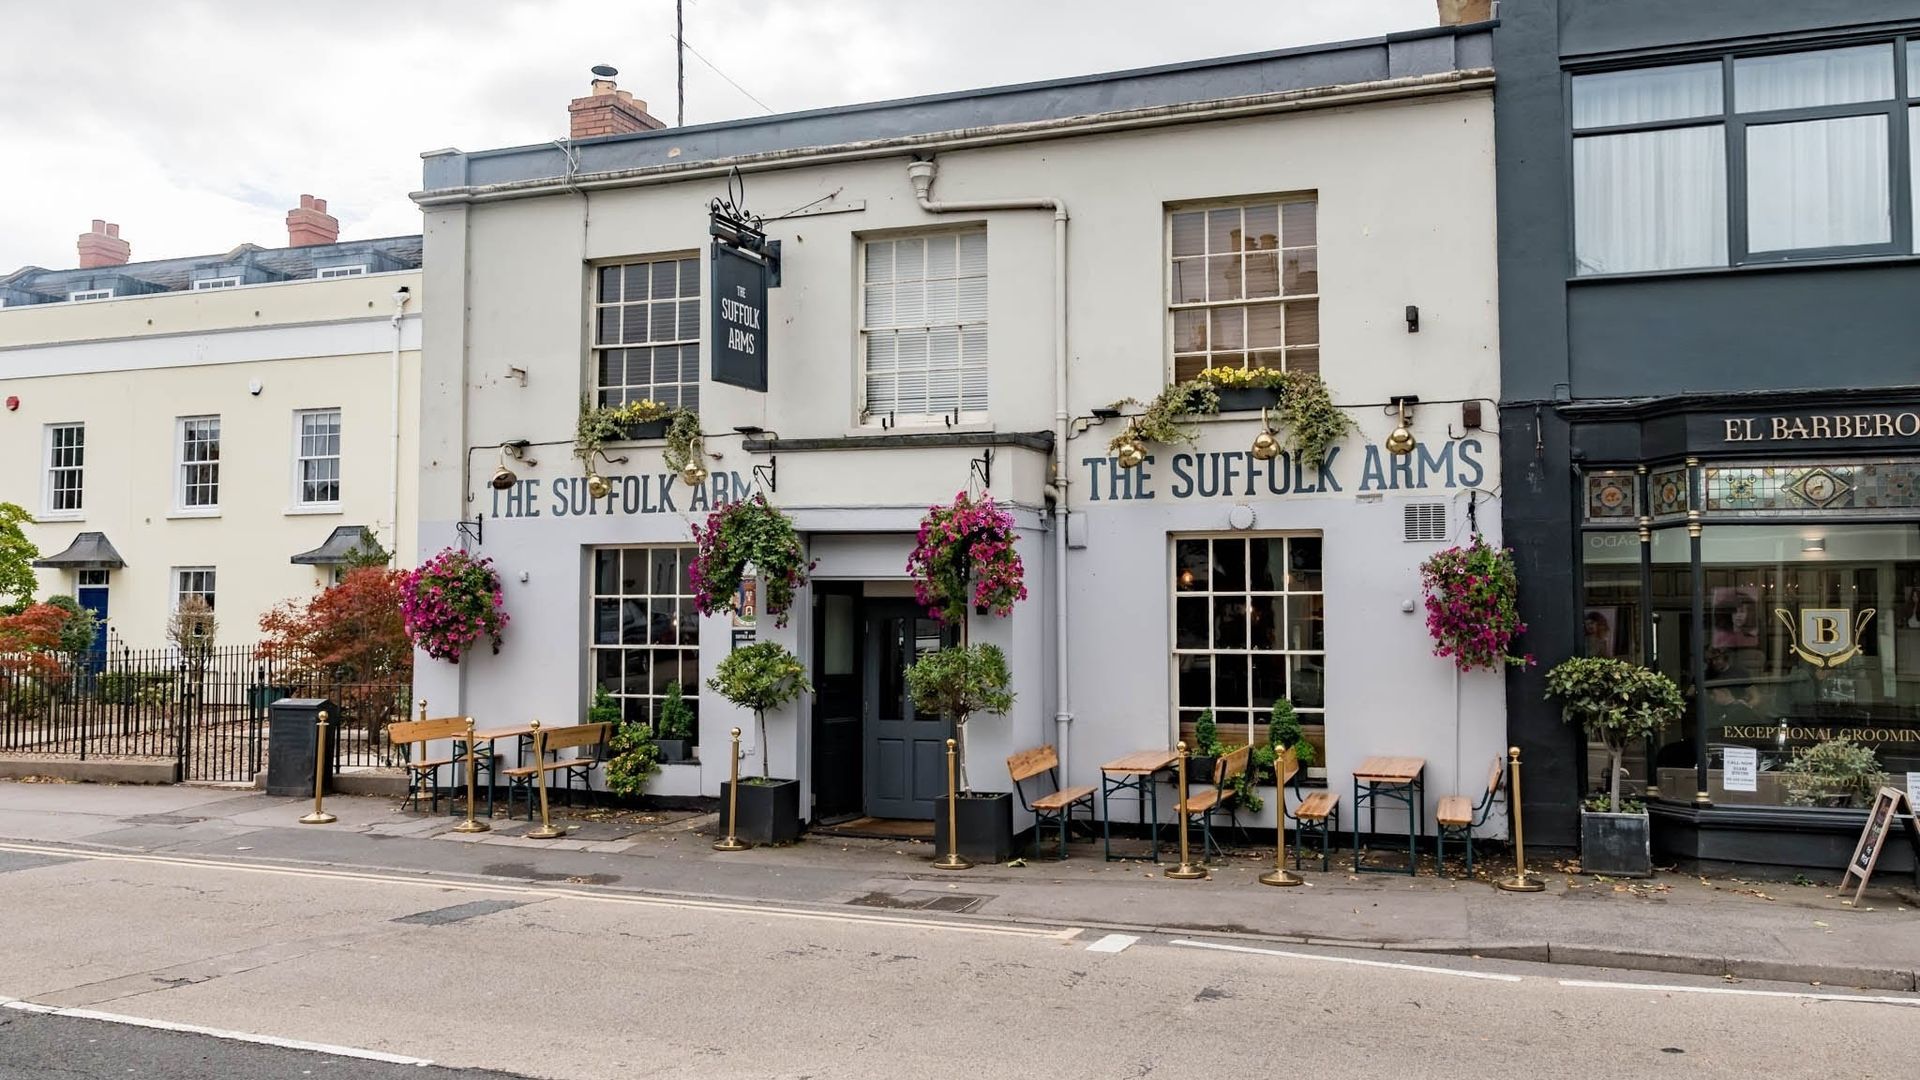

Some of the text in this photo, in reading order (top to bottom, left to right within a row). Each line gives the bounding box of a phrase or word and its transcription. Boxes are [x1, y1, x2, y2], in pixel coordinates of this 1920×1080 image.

[736, 285, 747, 299] THE
[721, 297, 760, 330] SUFFOLK
[728, 327, 755, 355] ARMS
[1724, 412, 1920, 442] EL BARBERO
[1082, 438, 1484, 501] THE SUFFOLK ARMS
[487, 479, 541, 518] THE
[688, 470, 752, 513] ARM
[1811, 616, 1840, 645] B
[1723, 725, 1836, 740] EXCEPTIONAL
